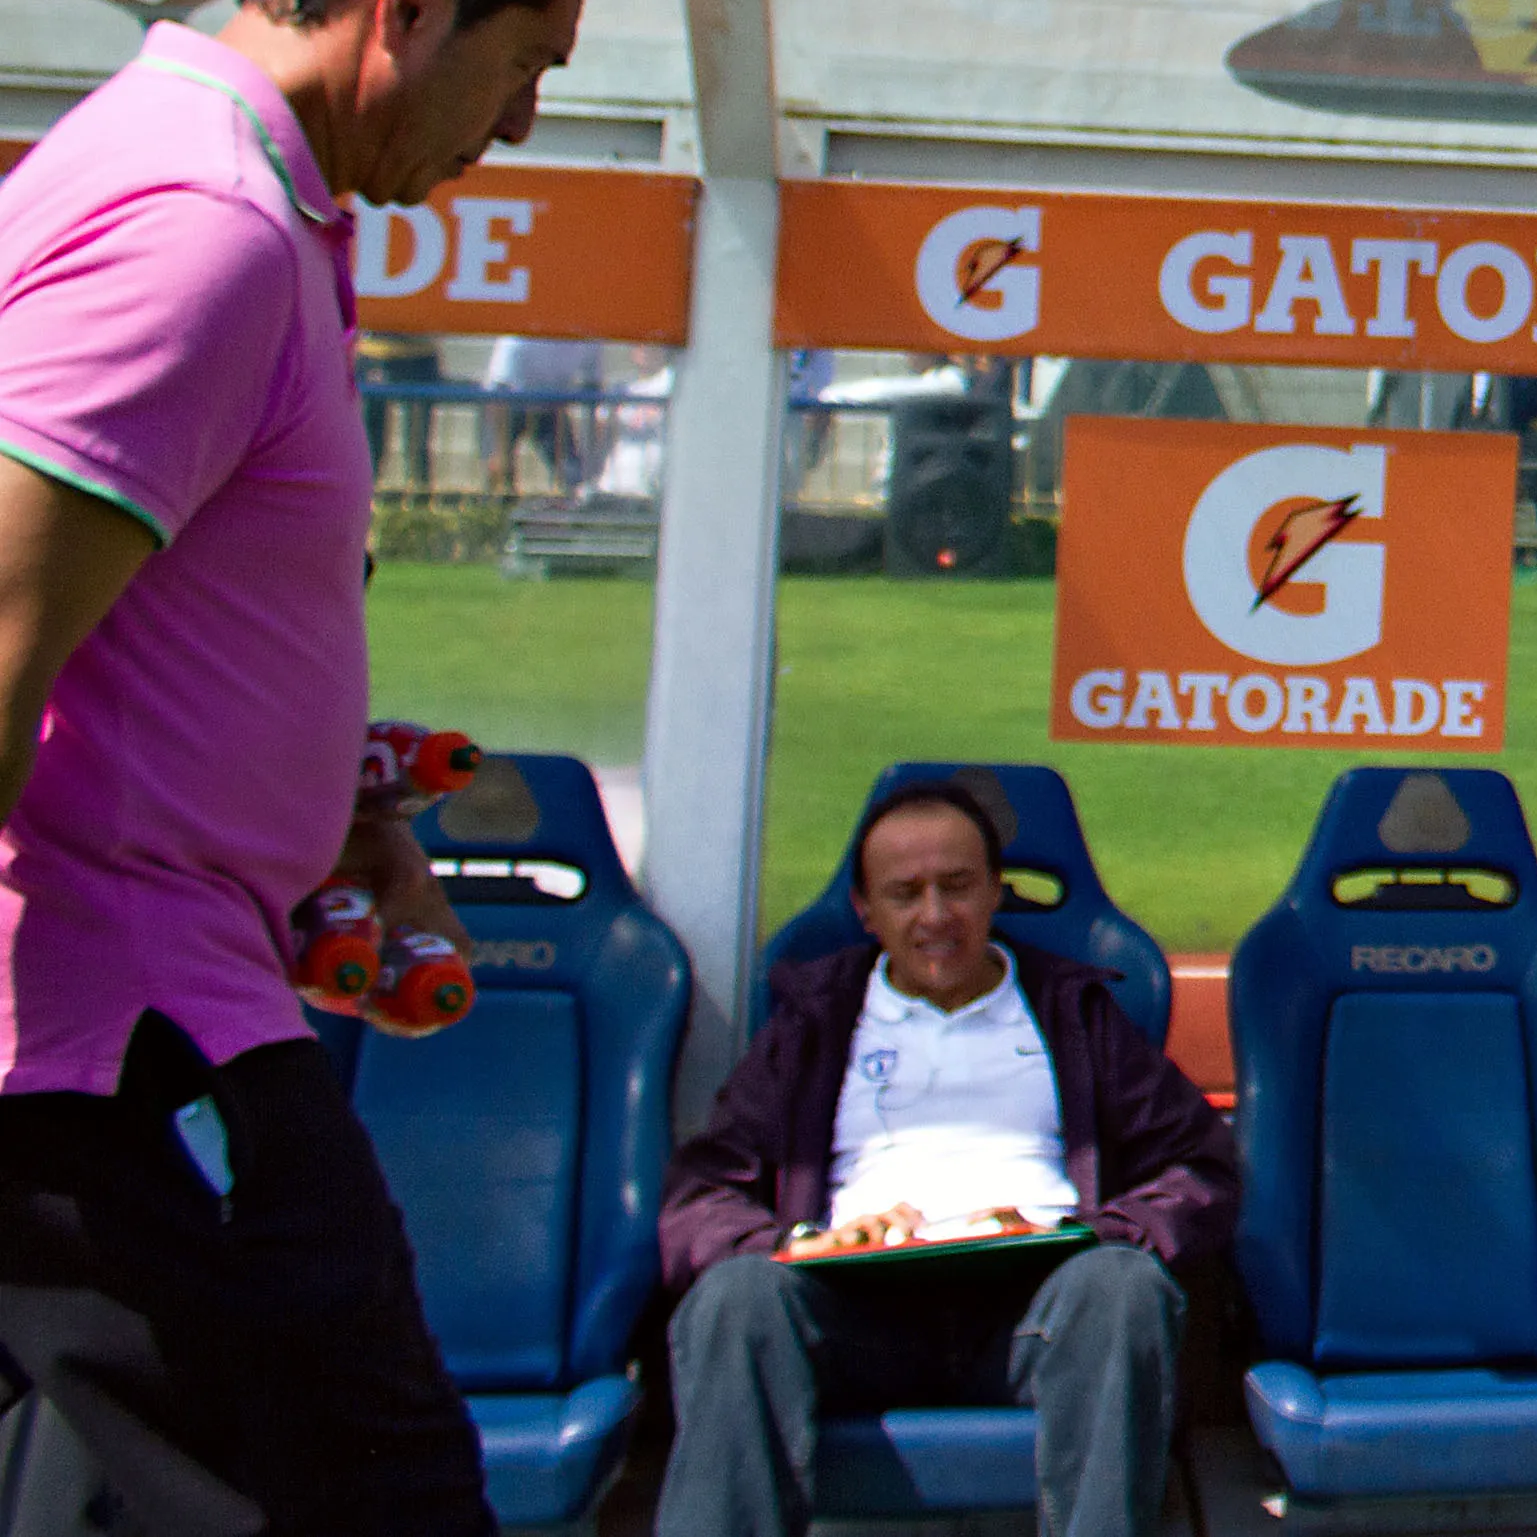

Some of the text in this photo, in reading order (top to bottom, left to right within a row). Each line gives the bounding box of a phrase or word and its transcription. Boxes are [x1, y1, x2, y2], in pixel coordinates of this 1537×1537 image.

[915, 205, 1042, 341] G
[1182, 443, 1386, 667] G
[1070, 669, 1487, 738] GATORADE
[1351, 944, 1498, 973] RECARO
